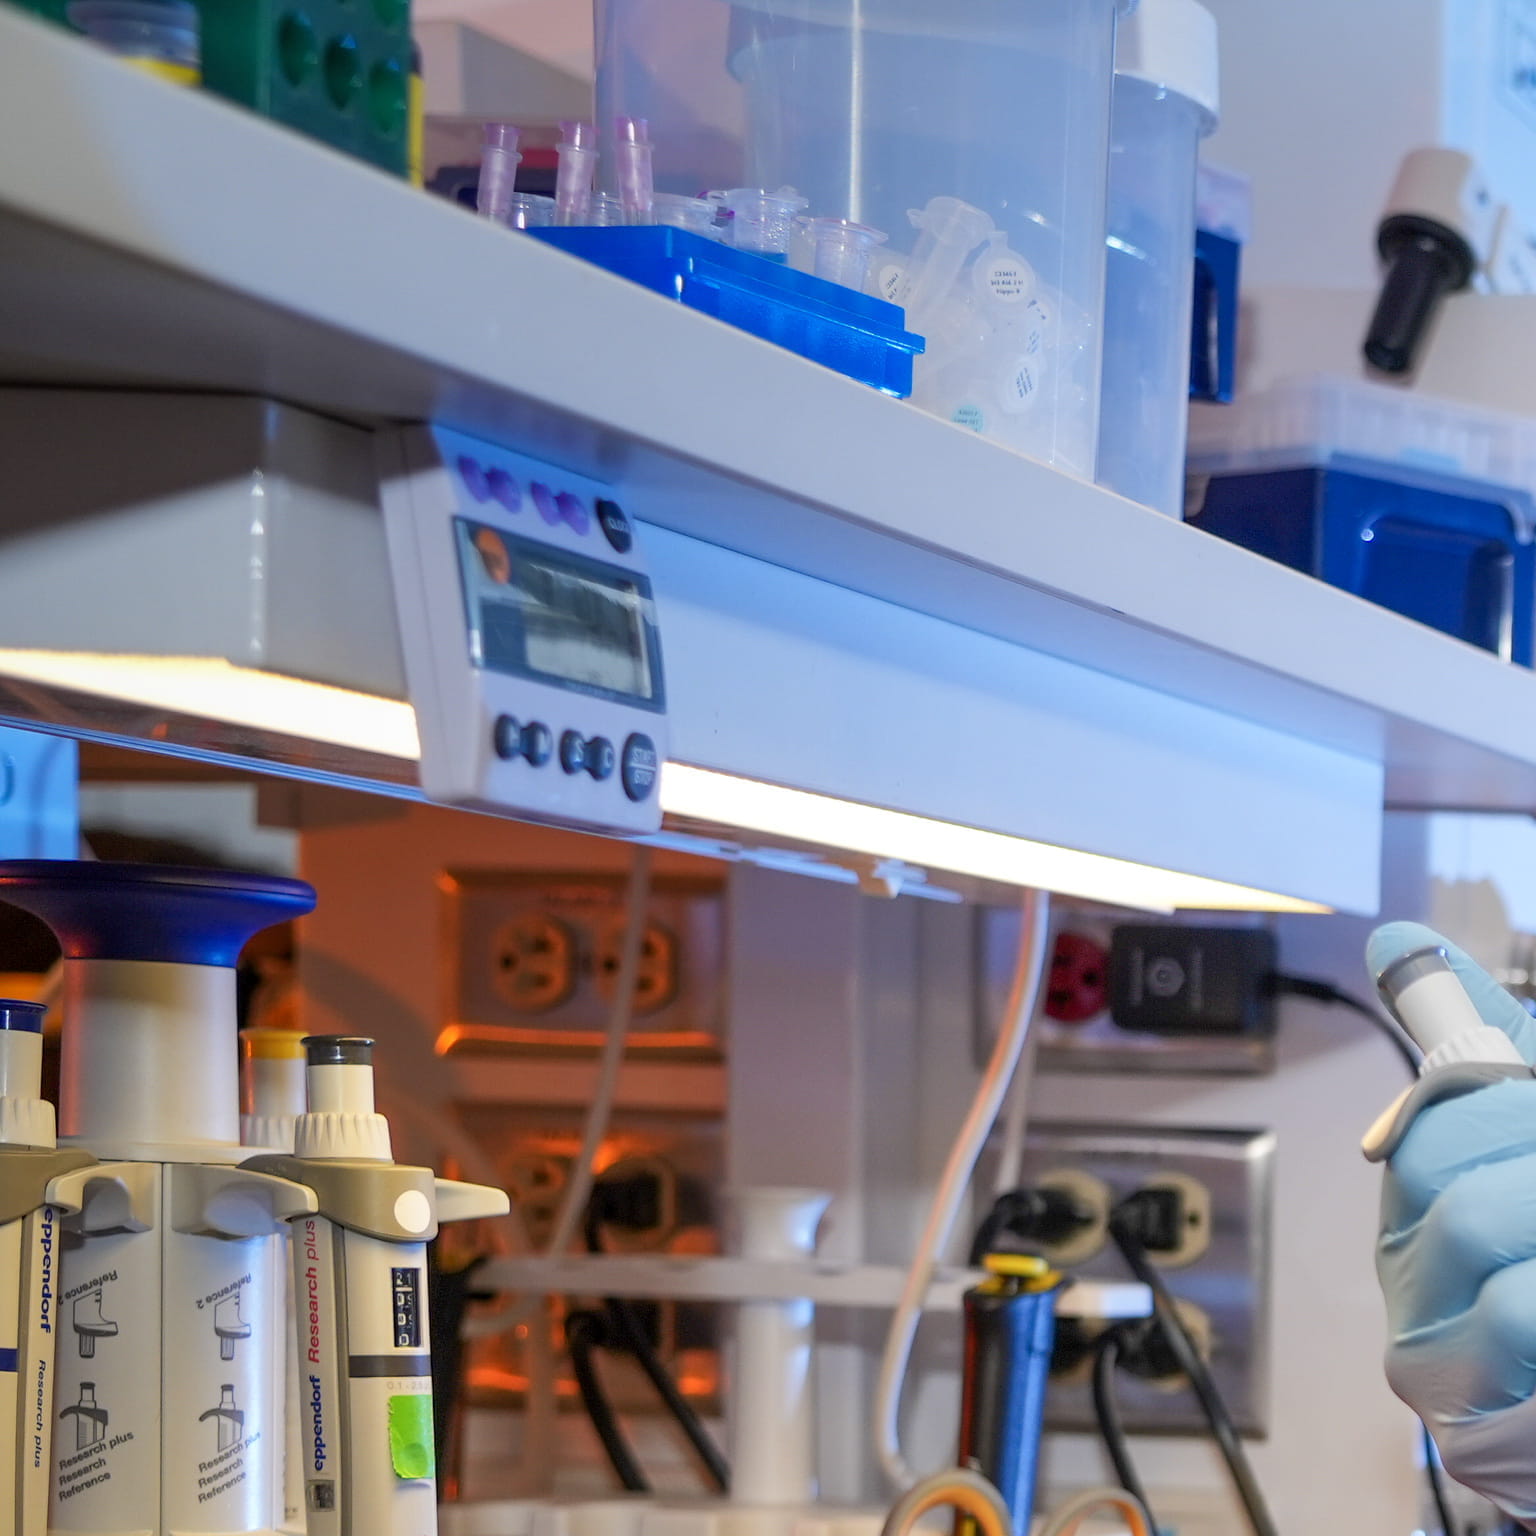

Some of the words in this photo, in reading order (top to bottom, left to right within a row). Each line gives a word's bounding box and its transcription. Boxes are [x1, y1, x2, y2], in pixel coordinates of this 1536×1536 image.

[305, 1219, 320, 1261] plus
[40, 1207, 54, 1334] eppendorf
[65, 1269, 118, 1300] Reference
[205, 1272, 252, 1304] Reference
[309, 1265, 322, 1364] Research
[36, 1359, 47, 1429] Research
[308, 1374, 324, 1472] eppendorf
[33, 1430, 42, 1469] plus
[59, 1442, 107, 1471] Research
[109, 1430, 134, 1450] plus
[198, 1441, 244, 1473] Research
[59, 1458, 106, 1486] Research
[59, 1472, 111, 1502] Reference
[198, 1458, 244, 1489] Research
[198, 1471, 248, 1504] Reference
